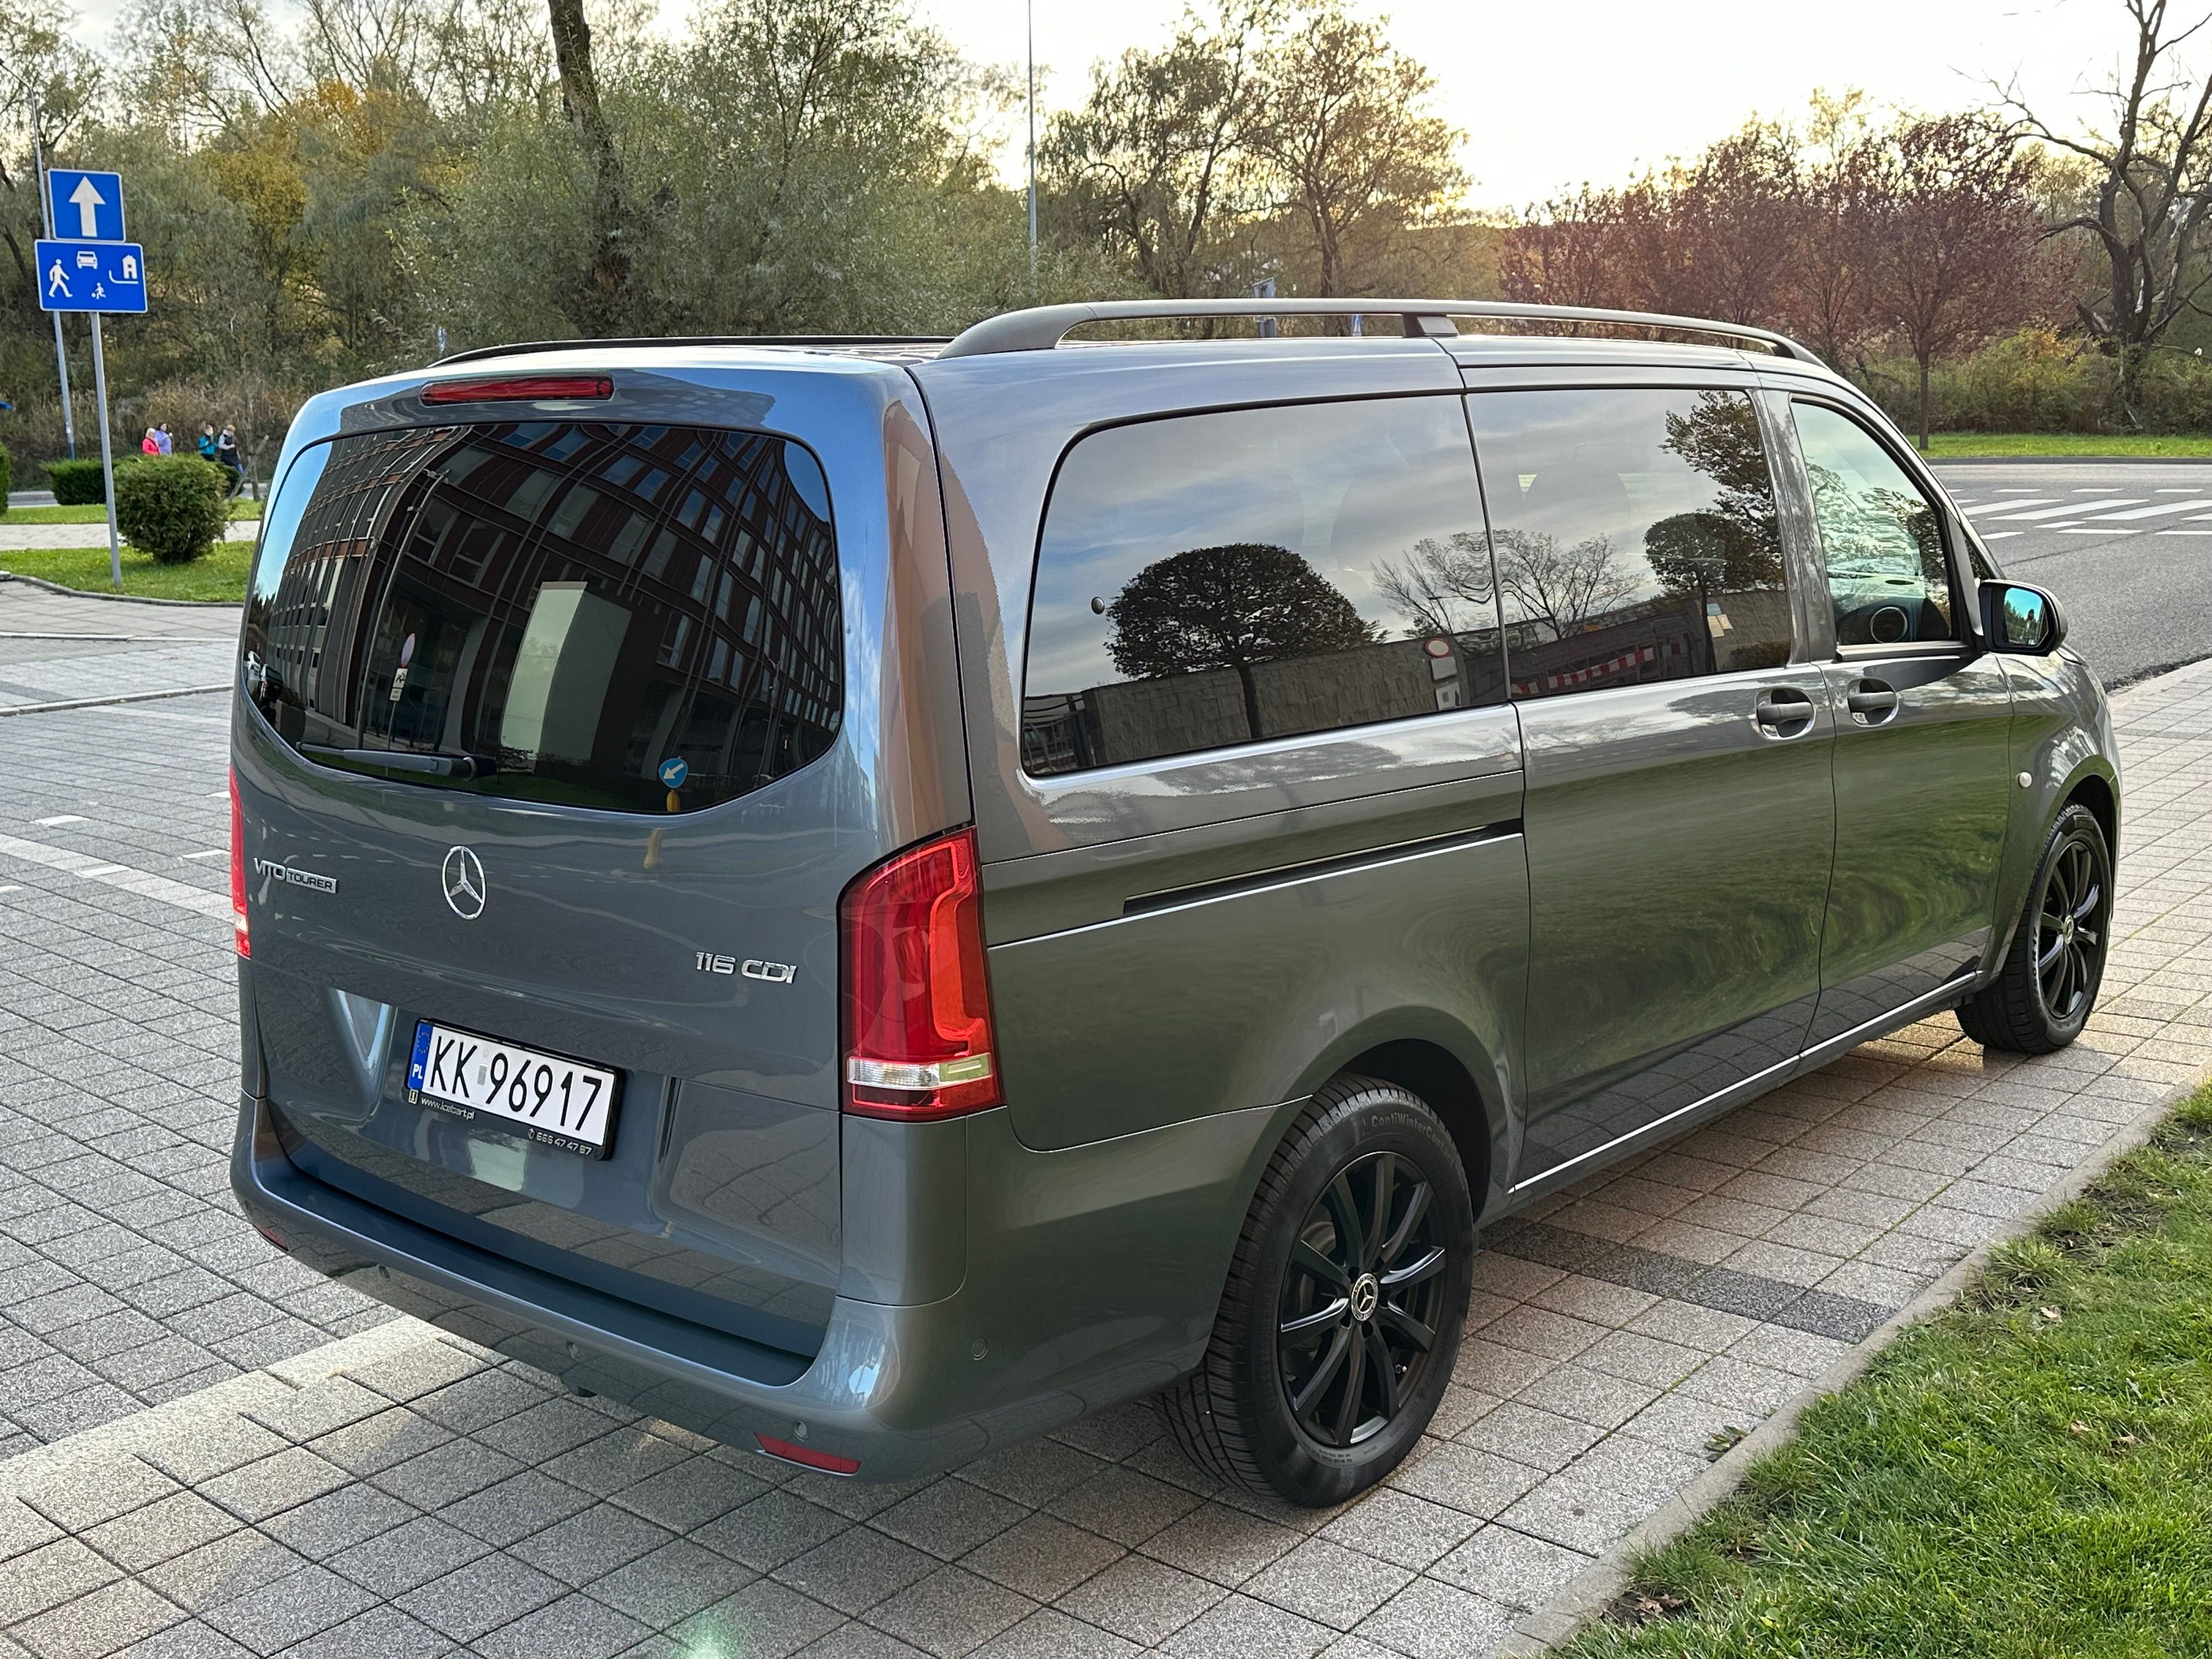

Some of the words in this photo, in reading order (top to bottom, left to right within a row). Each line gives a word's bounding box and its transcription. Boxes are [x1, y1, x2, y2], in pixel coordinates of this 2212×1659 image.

[254, 857, 286, 881] VITO
[287, 871, 334, 891] TOURER
[696, 951, 736, 974] 116
[741, 959, 797, 984] CDI
[412, 1063, 423, 1080] PL
[430, 1036, 477, 1098] KK
[486, 1052, 602, 1131] 96917
[554, 1138, 566, 1148] 47
[567, 1142, 579, 1151] 47
